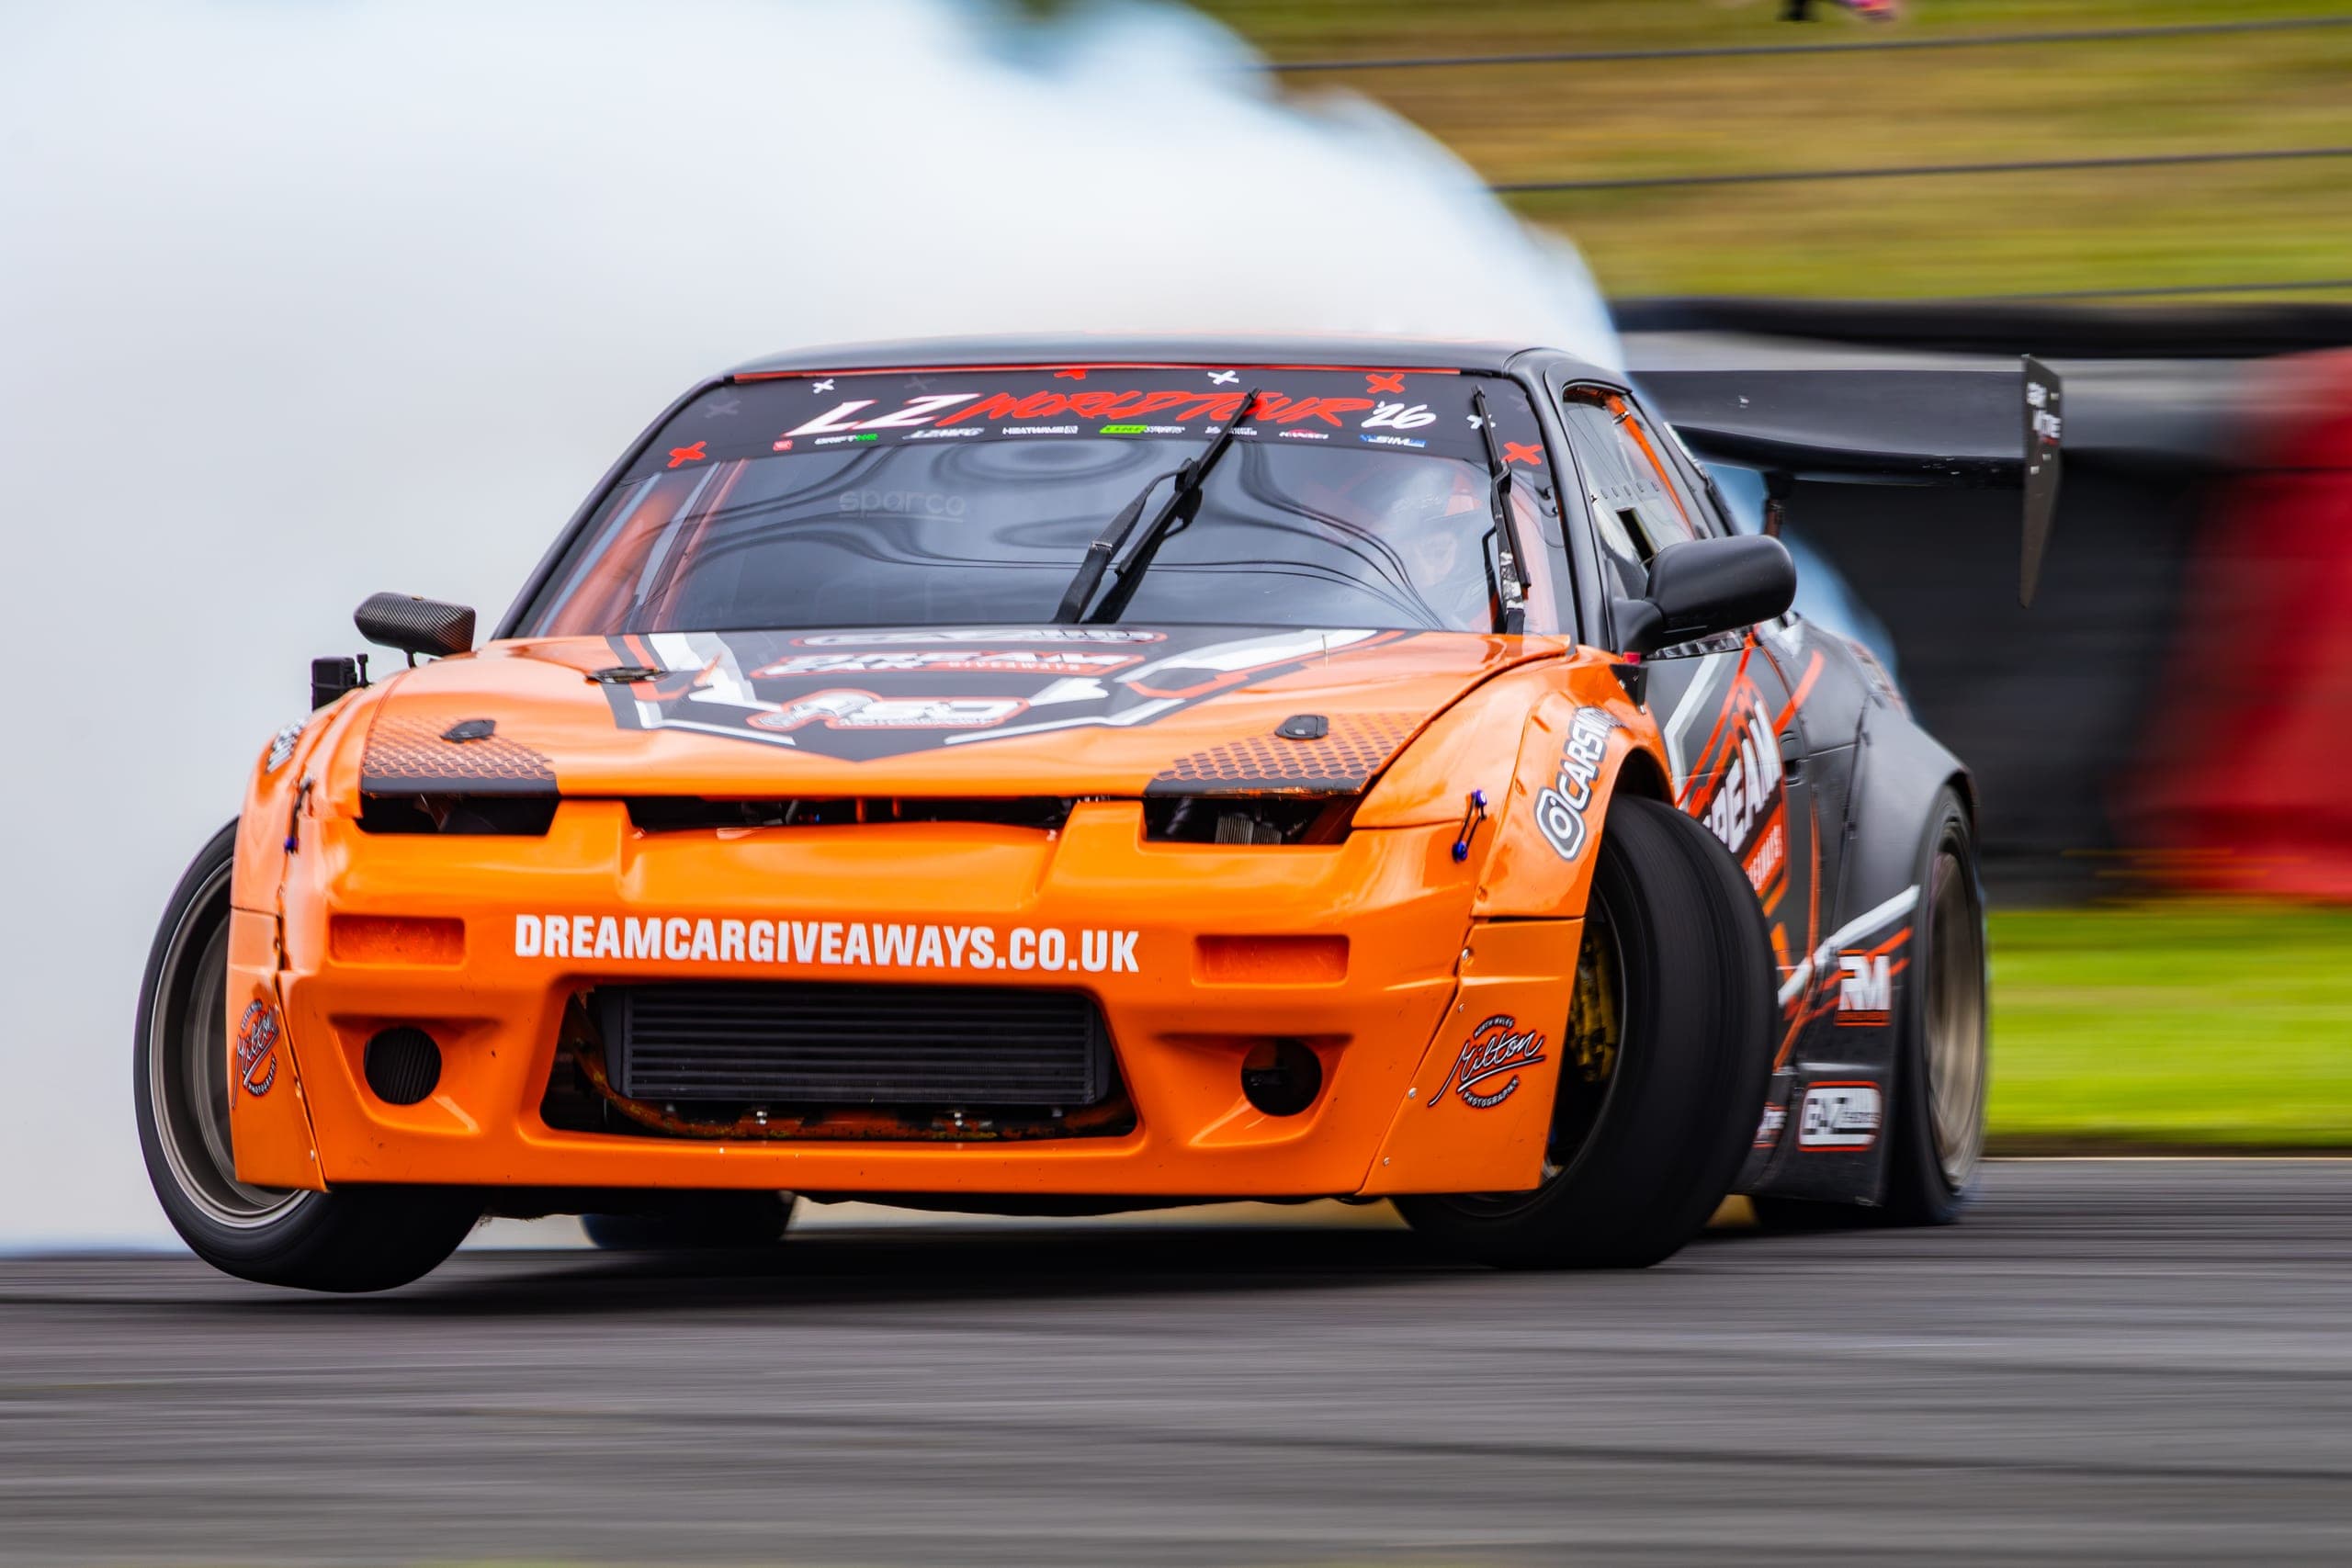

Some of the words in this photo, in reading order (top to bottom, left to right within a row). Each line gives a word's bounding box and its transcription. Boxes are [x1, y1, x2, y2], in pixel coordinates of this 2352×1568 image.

[783, 392, 982, 437] LZ
[838, 491, 966, 521] sparco
[1702, 700, 1781, 854] REAM
[514, 914, 1140, 974] DREAMCARGIVEAWAYS.CO.UK
[1428, 1031, 1545, 1107] Milton
